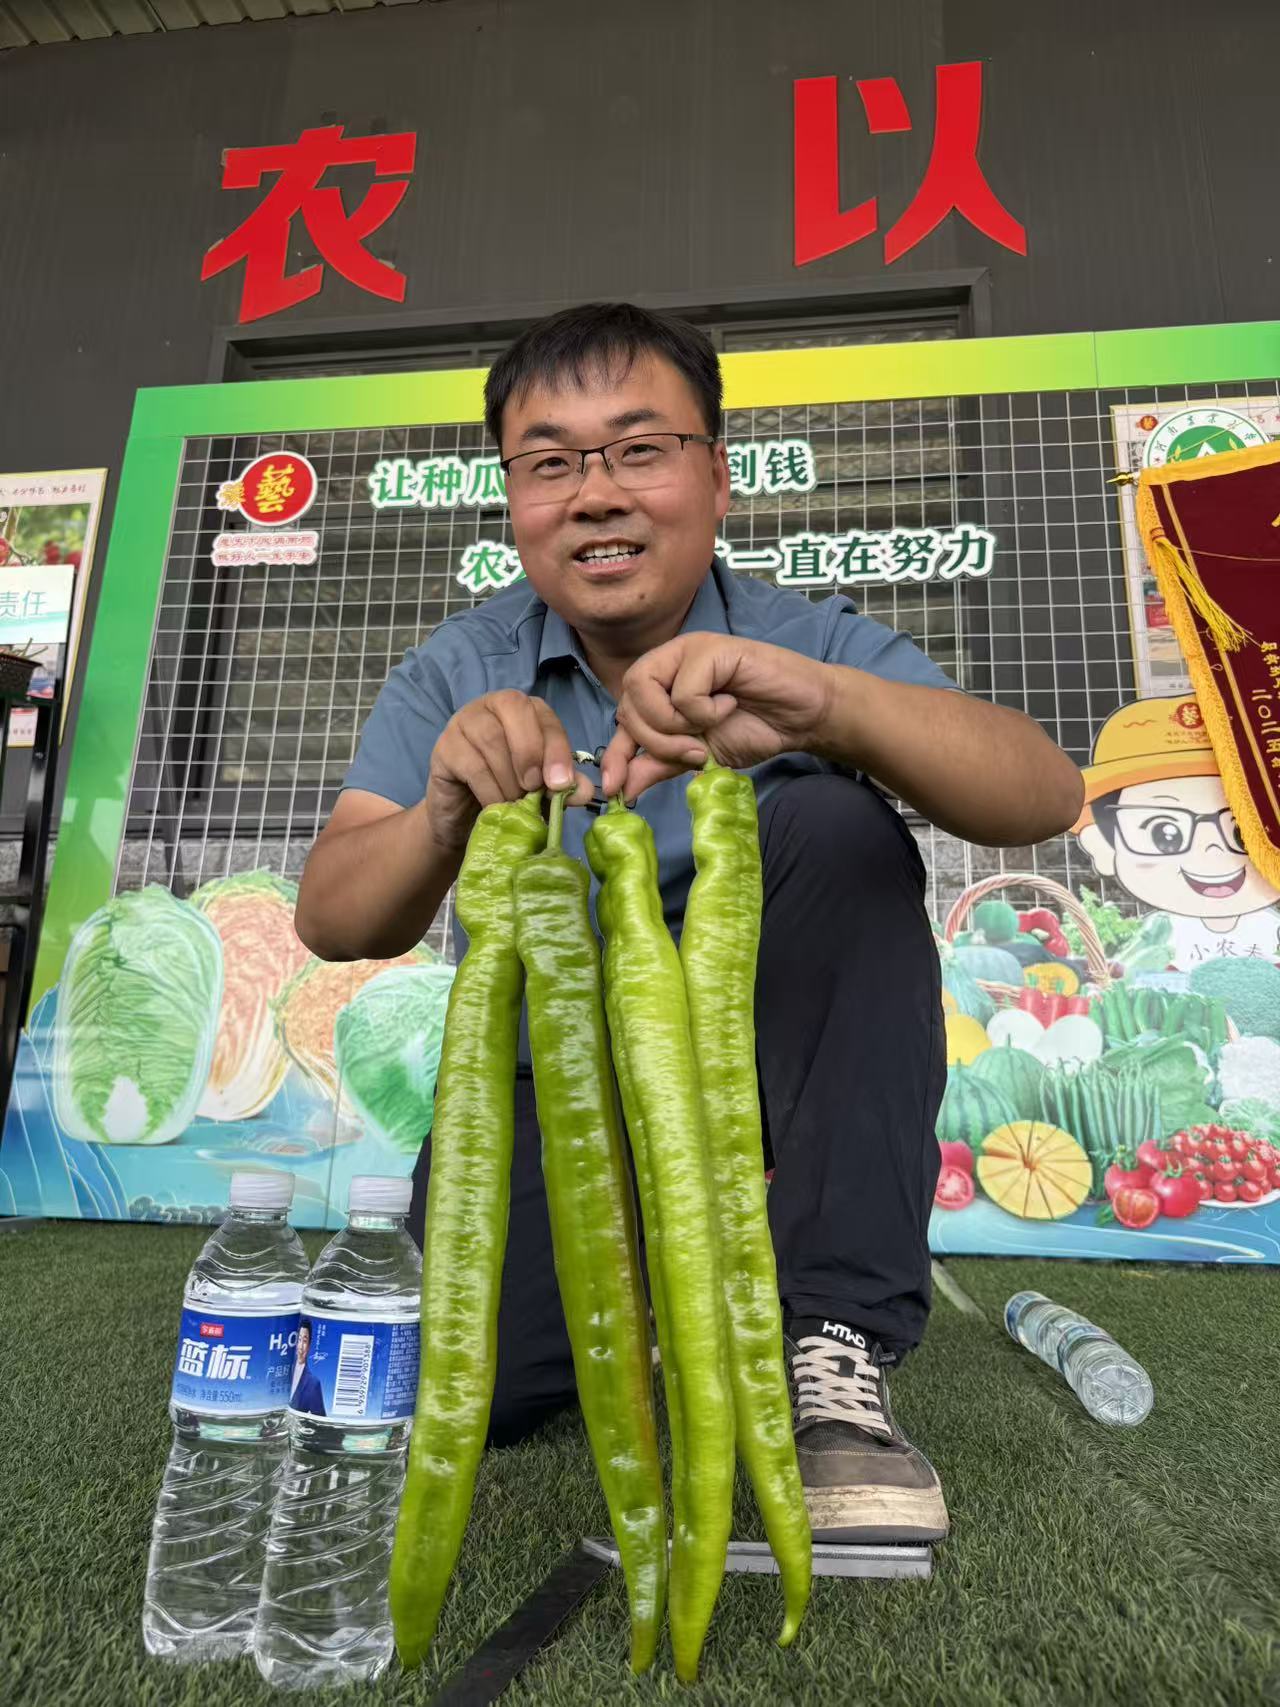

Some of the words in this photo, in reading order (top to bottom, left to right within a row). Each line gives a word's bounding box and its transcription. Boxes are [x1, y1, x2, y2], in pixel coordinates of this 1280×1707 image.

[200, 124, 417, 325] 农
[793, 61, 1028, 267] 以
[374, 462, 506, 502] 让种瓜
[714, 530, 988, 580] 一直在努力
[178, 1338, 253, 1380] 蓝标
